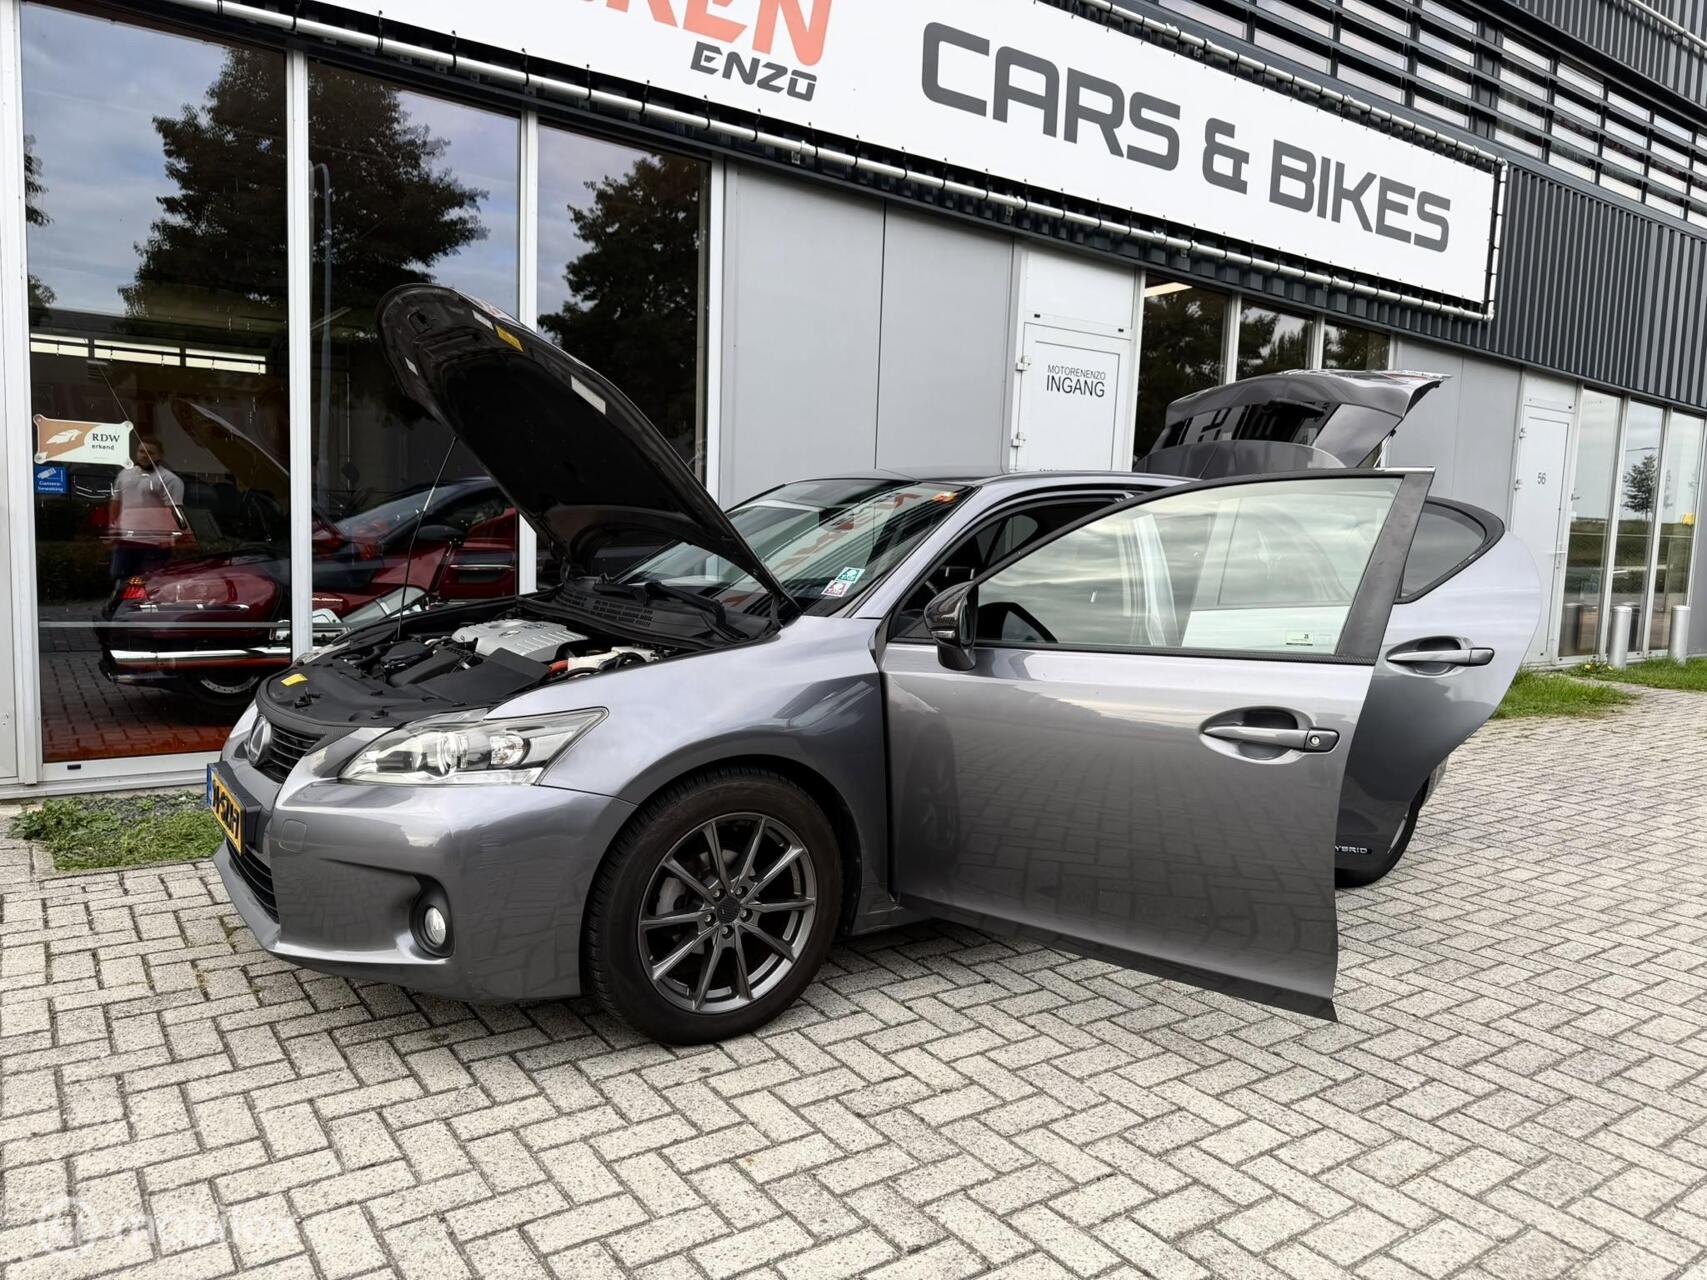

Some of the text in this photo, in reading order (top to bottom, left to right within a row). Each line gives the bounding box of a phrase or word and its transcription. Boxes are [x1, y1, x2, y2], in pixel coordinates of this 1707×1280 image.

[584, 0, 832, 67] EN
[690, 41, 817, 102] ENZO
[922, 22, 1451, 253] CARS & BIKES
[1047, 364, 1106, 380] MOTORENENZO
[1047, 374, 1105, 397] INGANG
[92, 433, 120, 442] RDW
[1537, 471, 1547, 485] 56
[1335, 845, 1367, 853] YBRID
